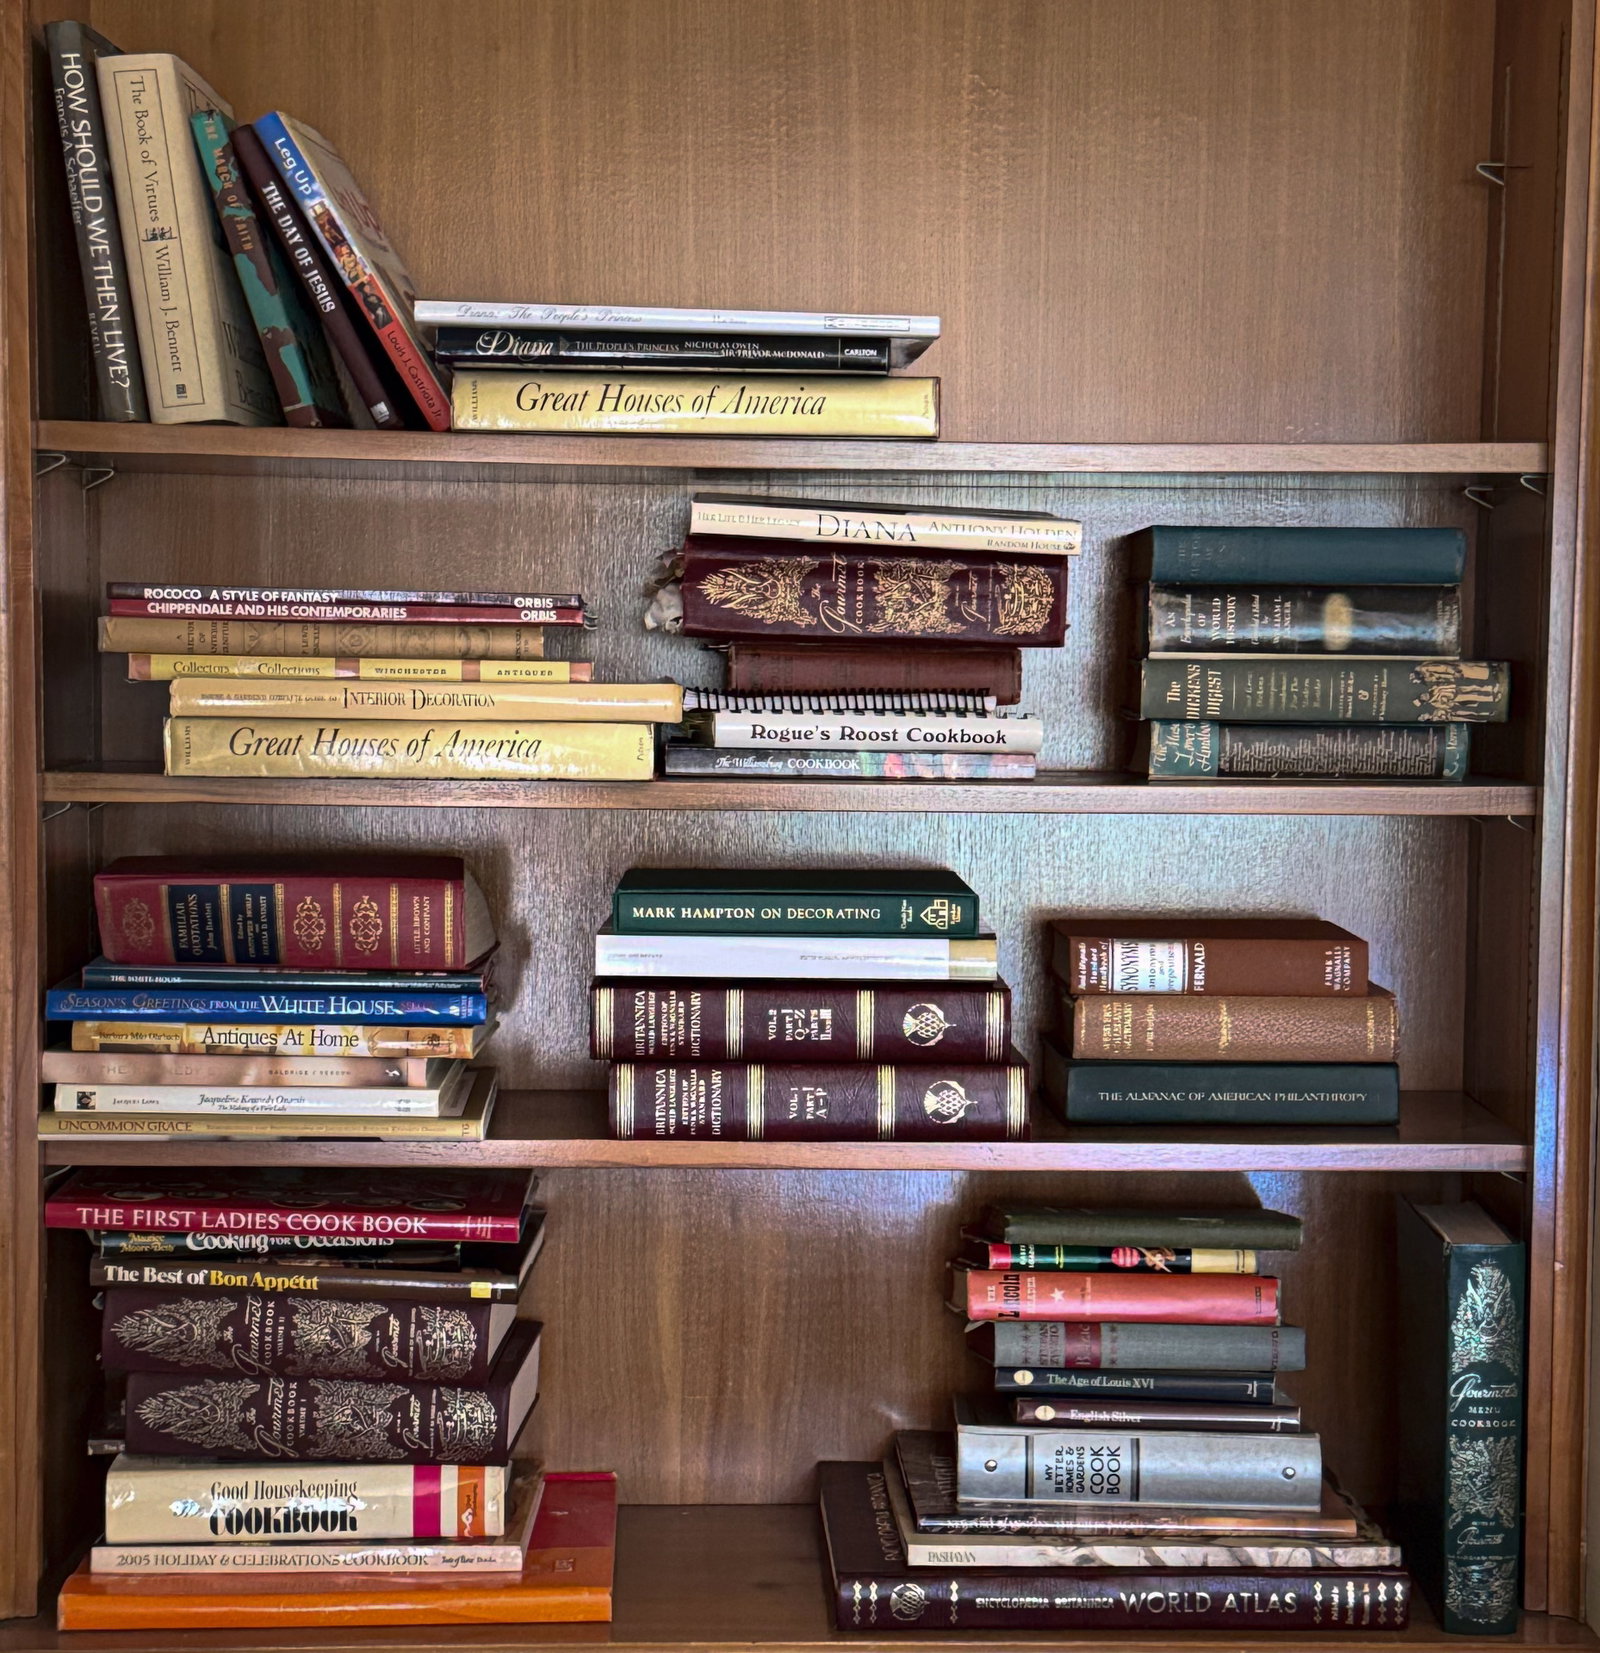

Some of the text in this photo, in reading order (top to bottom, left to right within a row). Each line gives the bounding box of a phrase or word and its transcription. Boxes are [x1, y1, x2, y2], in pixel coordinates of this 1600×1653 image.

[130, 76, 160, 222] The Book of Virtues
[274, 137, 313, 195] Leg Up
[61, 53, 131, 388] HOW SHOULD WE THEN LIVE?
[262, 181, 336, 313] THE DAY OF JESUS
[156, 244, 173, 302] William
[165, 320, 182, 373] Bennett
[508, 306, 531, 319] The
[594, 308, 643, 323] Princess
[475, 330, 554, 361] Diana
[575, 340, 680, 353] THE PRINCESS
[732, 342, 760, 351] OWEN
[516, 382, 827, 419] Great Houses of America
[816, 513, 916, 541] DIANA
[929, 521, 1077, 538] ANTHONY HOLDEN
[987, 539, 1062, 550] RANDOM HOUSE
[144, 588, 338, 603] ROCOCO A STYLE OF FANTASY
[514, 597, 553, 608] ORBIS
[819, 552, 862, 634] Gourmet
[856, 562, 865, 624] COOKBOOK
[147, 603, 407, 619] CHIPPENDALE AND HIS CONTEMPORARIES
[521, 610, 557, 620] ORBIS
[1212, 598, 1221, 641] WORLD
[1226, 594, 1236, 644] HISTORY
[173, 661, 229, 674] Collectors
[343, 688, 495, 709] INTERIOR DECORATION
[1167, 681, 1180, 703] The
[1186, 664, 1200, 719] DICKENS
[1207, 668, 1223, 715] DIGEST
[229, 727, 542, 763] Great Houses of America
[751, 725, 1007, 744] Rogue's Roost Cookbook
[788, 758, 860, 770] COOKBOOK
[176, 903, 188, 949] FAMILIAR
[188, 894, 203, 956] QUOTATIONS
[633, 907, 880, 919] MARK HAMPTON ON DECORATING
[1090, 948, 1098, 984] Standard
[1120, 942, 1139, 991] SYNONYMS
[1194, 943, 1205, 991] FERNALD
[60, 992, 127, 1010] SEASON'S
[132, 992, 206, 1009] GREETINGS
[209, 1000, 237, 1009] FROM
[241, 1001, 260, 1009] THE
[260, 995, 324, 1014] WHITE
[328, 996, 395, 1015] HOUSE
[203, 1027, 359, 1048] Antiques At Home
[635, 990, 646, 1056] BRITANNICA
[691, 991, 701, 1056] DICTIONARY
[786, 1016, 794, 1041] PART
[810, 1009, 818, 1041] PARTS
[198, 1094, 239, 1105] Jacqueline
[656, 1069, 666, 1135] BRITANNICA
[711, 1069, 722, 1135] DICTIONARY
[806, 1094, 814, 1120] PART
[1098, 1091, 1368, 1102] THE ALMANAC OF AMERICAN PHILANTHROPY
[58, 1120, 192, 1131] UNCOMMON GRACE
[76, 1208, 427, 1234] THE FIRST LADIES COOK BOOK
[185, 1231, 291, 1253] Cooking FOR
[104, 1265, 320, 1291] The Best of Bon Appétit
[998, 1274, 1020, 1318] Lincoln
[232, 1294, 277, 1376] Gourmet
[264, 1300, 275, 1366] COOKBOOK
[1046, 1374, 1154, 1389] The Age of Louis XVI
[254, 1377, 299, 1457] Gourmet
[286, 1382, 297, 1447] COOKBOOK
[1070, 1410, 1142, 1424] English Silver
[1451, 1419, 1516, 1428] COOKBOOK
[1045, 1464, 1053, 1481] MY
[1055, 1445, 1064, 1493] BETTER
[1065, 1447, 1075, 1494] HOMES &
[1076, 1446, 1085, 1494] GARDENS
[1090, 1446, 1104, 1495] COOK
[1107, 1446, 1120, 1495] BOOK
[211, 1479, 358, 1500] Good Housekeeping
[209, 1505, 357, 1536] COOKBOOK
[116, 1554, 429, 1566] 2005 HOLIDAY & CELEBRATIONS COOKBOOK
[1055, 1592, 1297, 1614] BRITANNICA WORLD ATLAS
